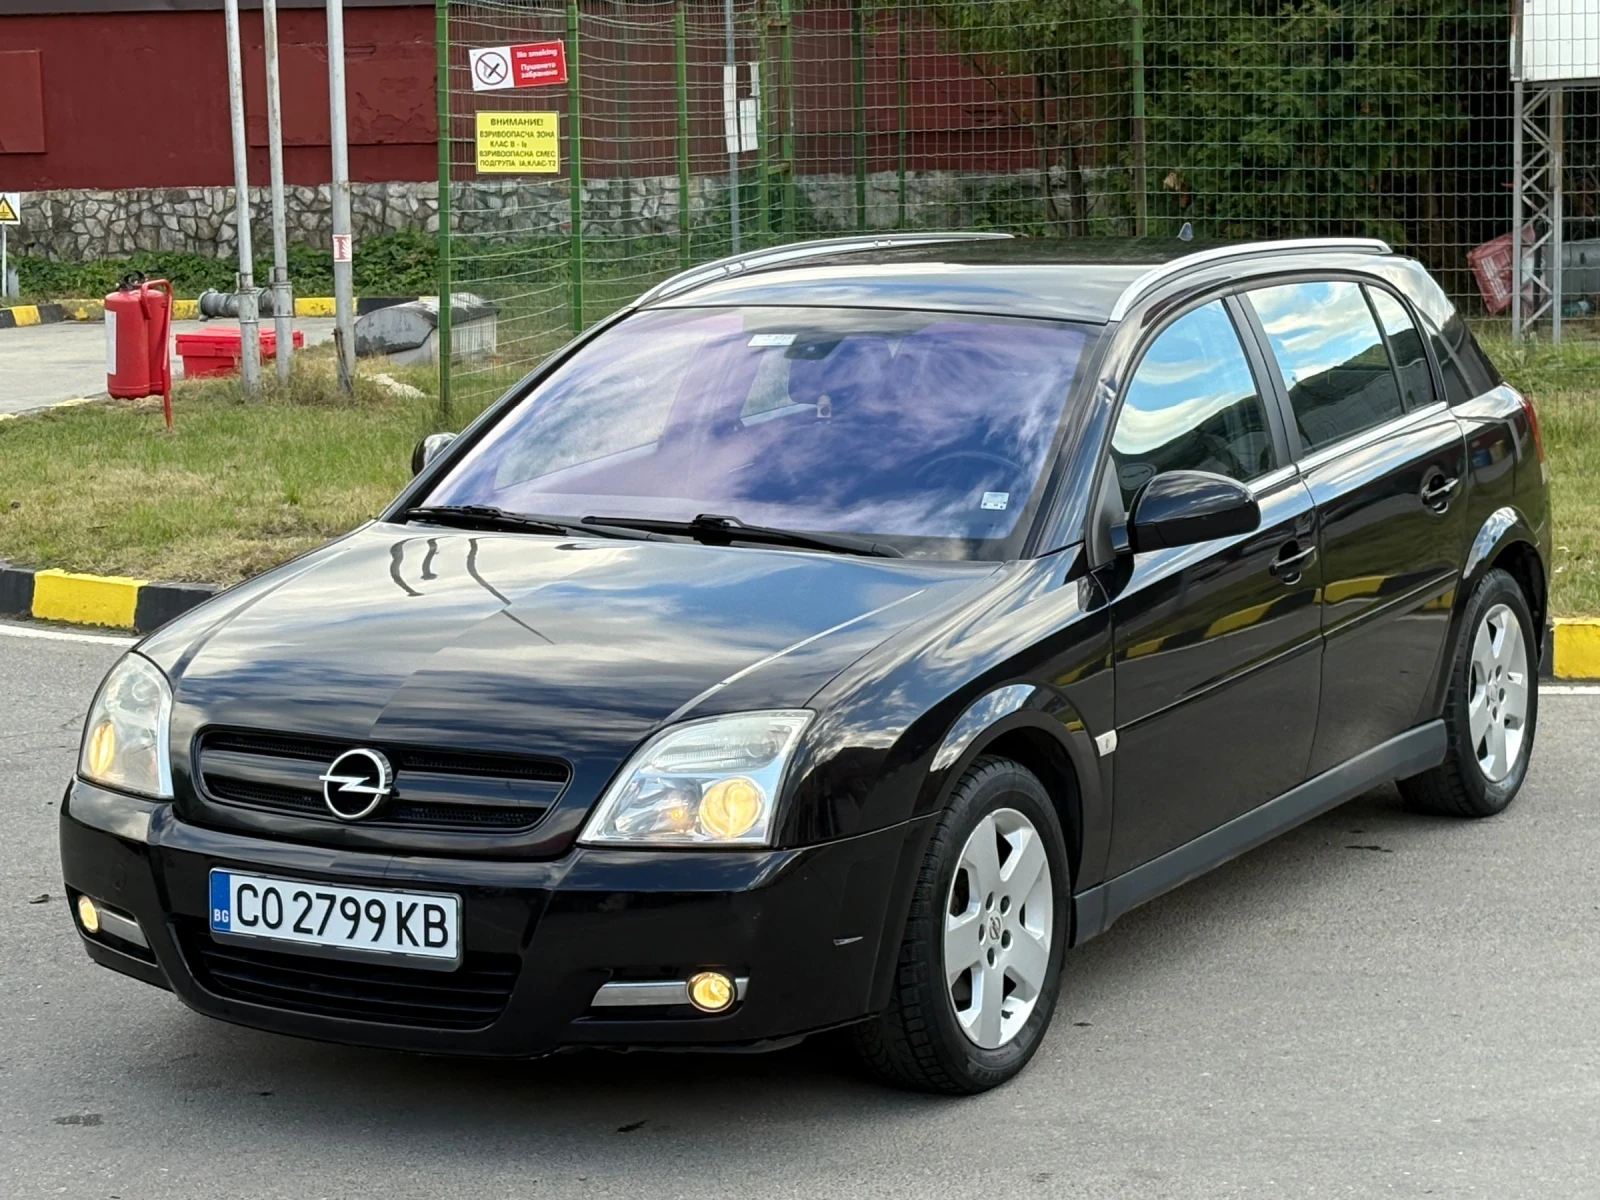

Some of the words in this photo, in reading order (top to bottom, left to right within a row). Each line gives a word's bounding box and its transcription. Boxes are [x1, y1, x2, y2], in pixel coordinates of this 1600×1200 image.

[516, 50, 527, 59] No
[528, 48, 558, 57] smoking
[490, 118, 544, 126] ВНИМАНИЕ!
[489, 140, 509, 148] КЛАС
[213, 908, 230, 923] BG
